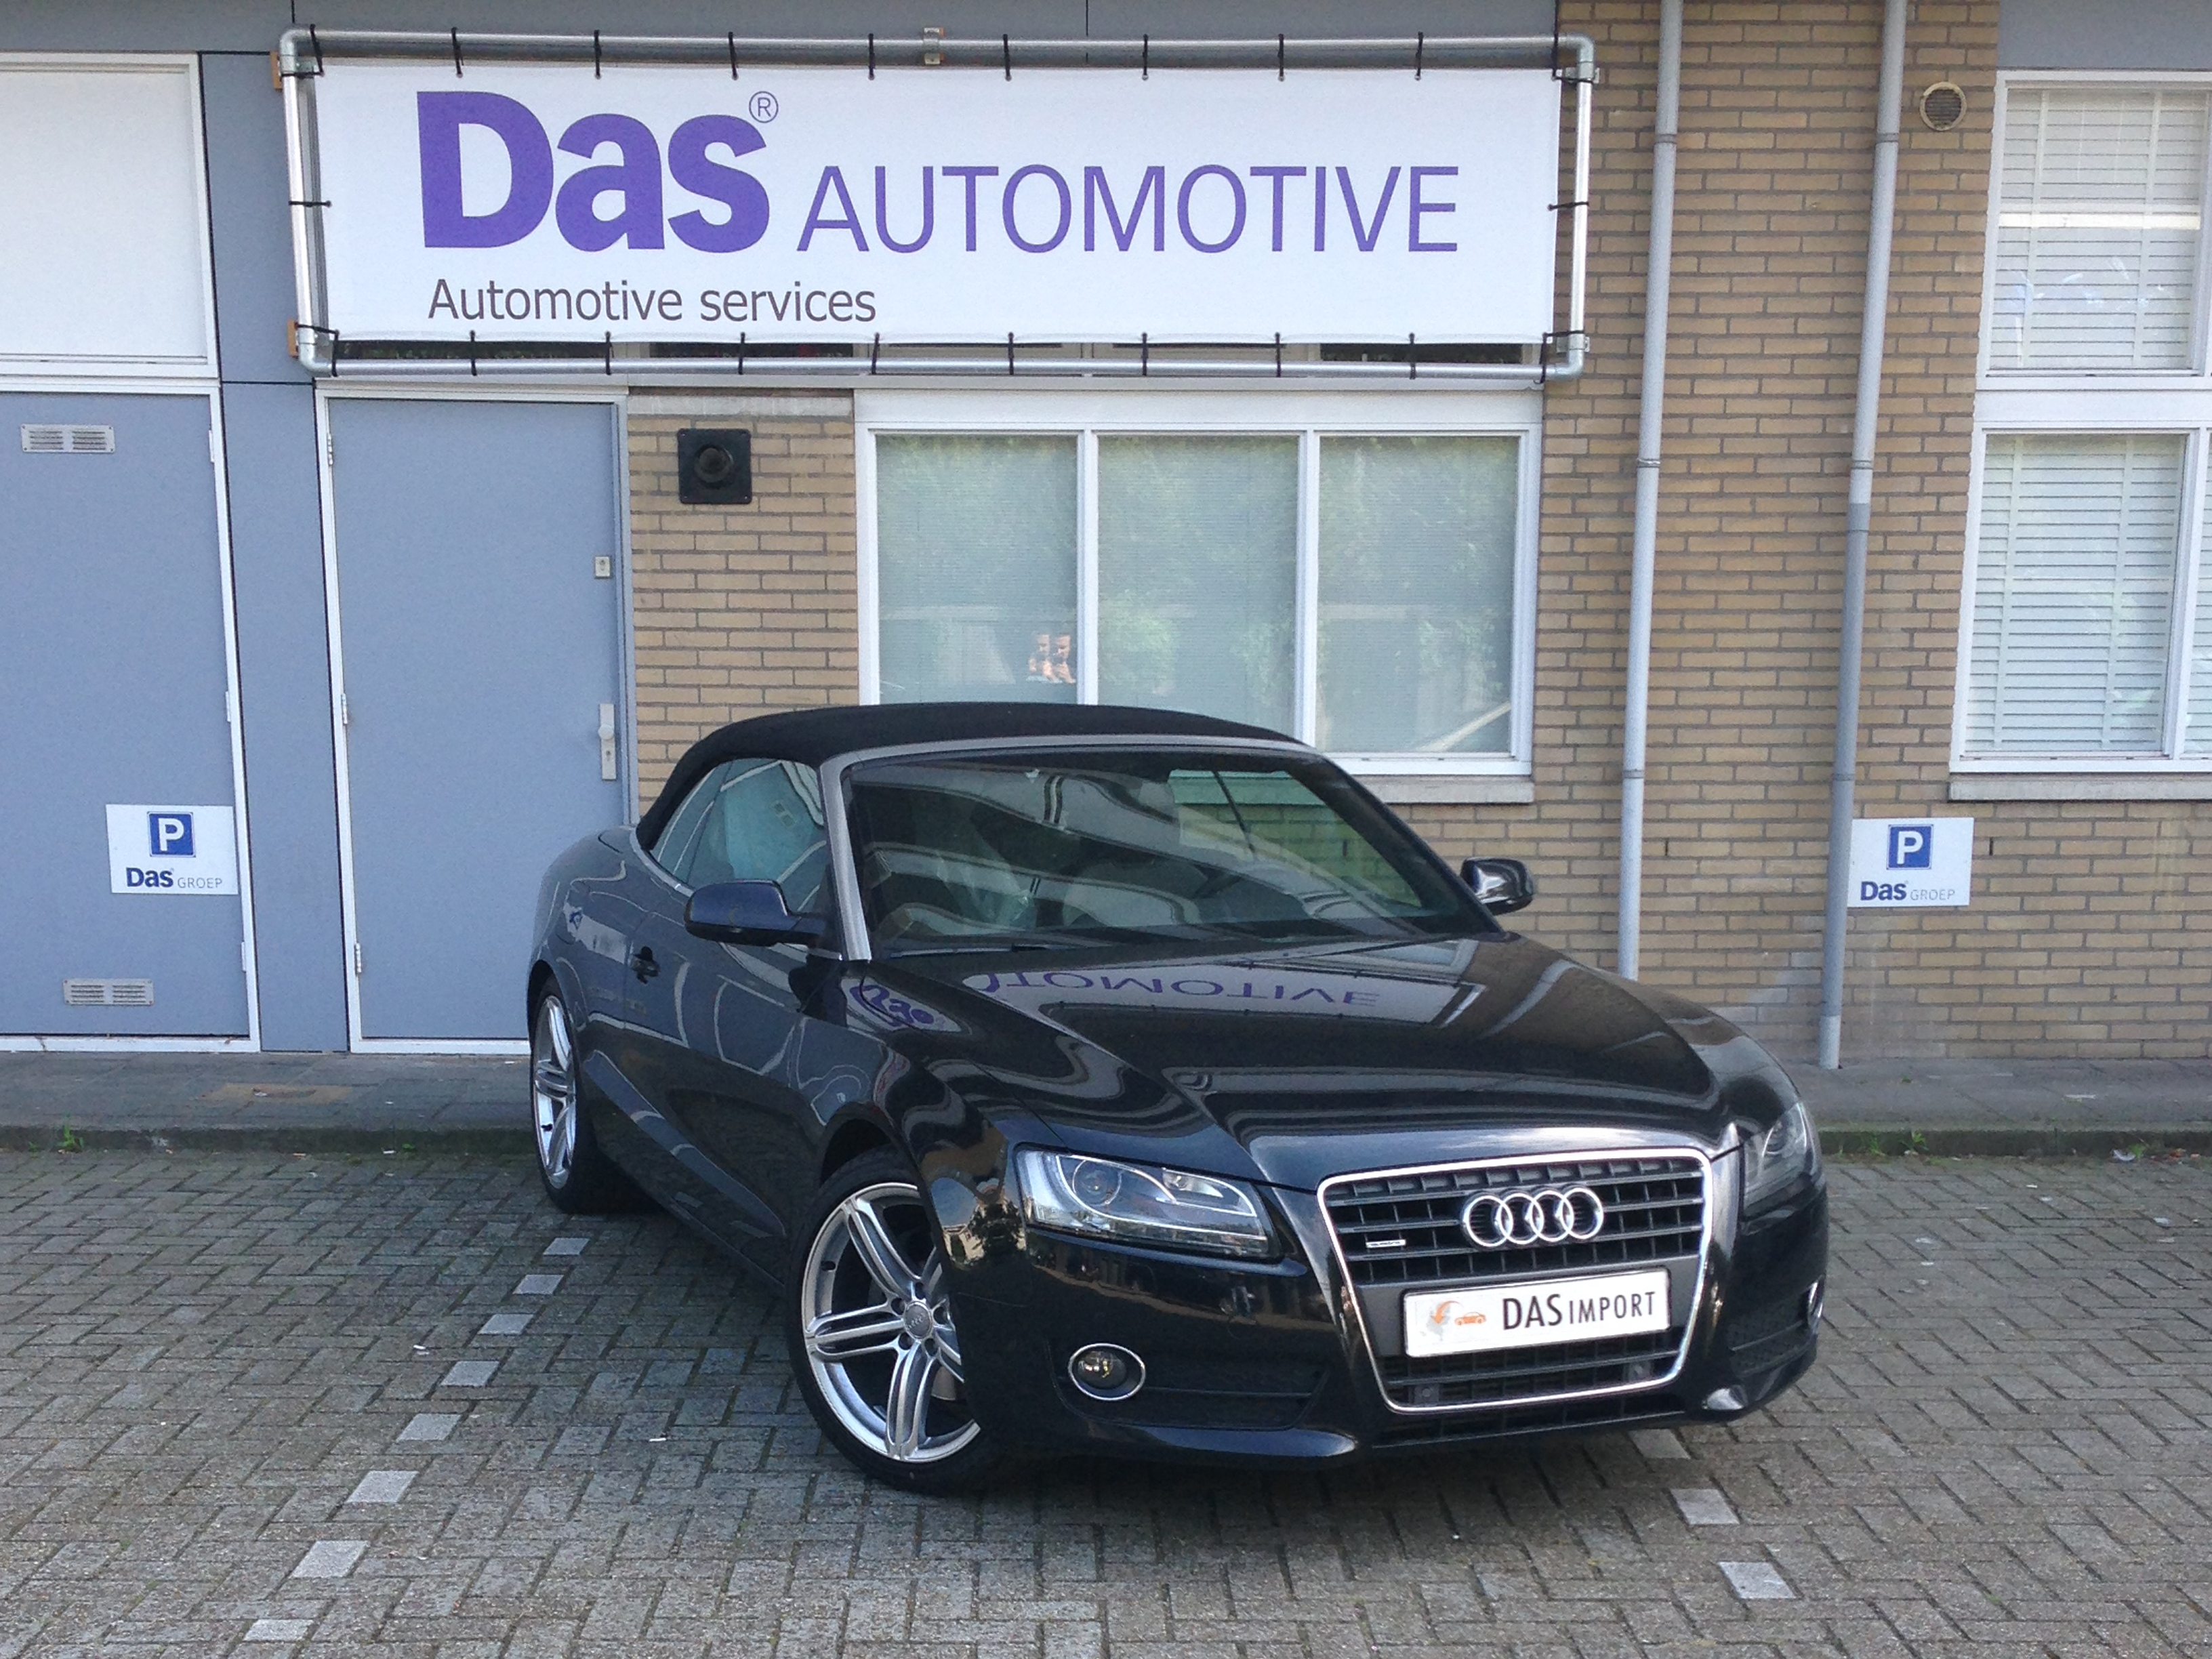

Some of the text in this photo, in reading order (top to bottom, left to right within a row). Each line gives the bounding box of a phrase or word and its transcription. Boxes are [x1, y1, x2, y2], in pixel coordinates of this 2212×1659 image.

[416, 90, 771, 253] Das
[796, 164, 1459, 253] AUTOMOTIVE
[428, 279, 877, 322] Automotive services
[158, 817, 184, 852] P
[1896, 830, 1923, 865] P
[125, 867, 223, 889] Das GROEP
[1860, 880, 1956, 901] Das GROEP
[1502, 1290, 1656, 1330] DAS IMPORT
